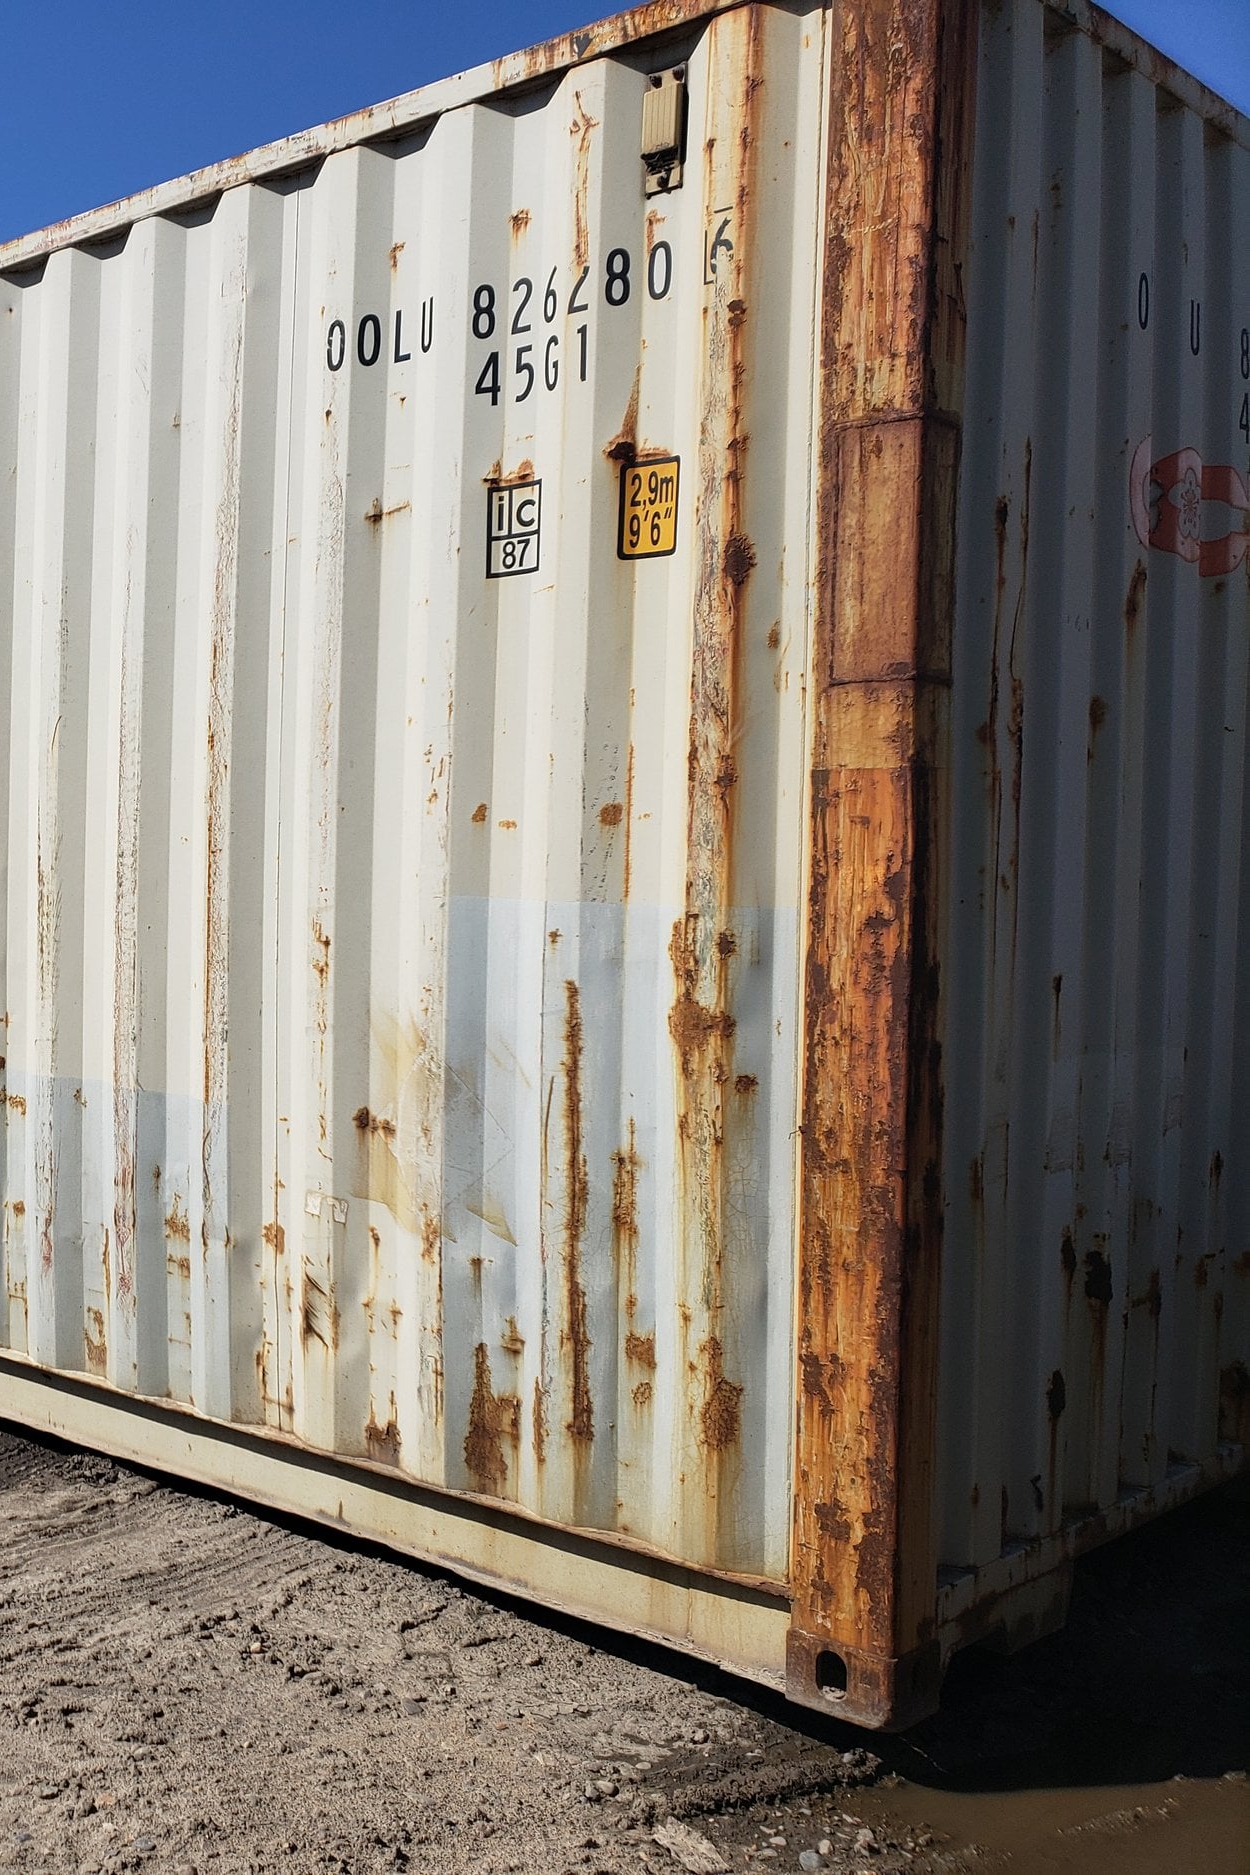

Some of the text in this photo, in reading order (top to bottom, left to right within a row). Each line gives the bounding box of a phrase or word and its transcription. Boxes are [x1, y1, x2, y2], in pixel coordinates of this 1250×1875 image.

[326, 296, 434, 371] OOLU
[472, 240, 672, 340] 826280
[475, 324, 588, 406] 45G1
[630, 470, 674, 511] 2,9m
[502, 538, 531, 570] 87
